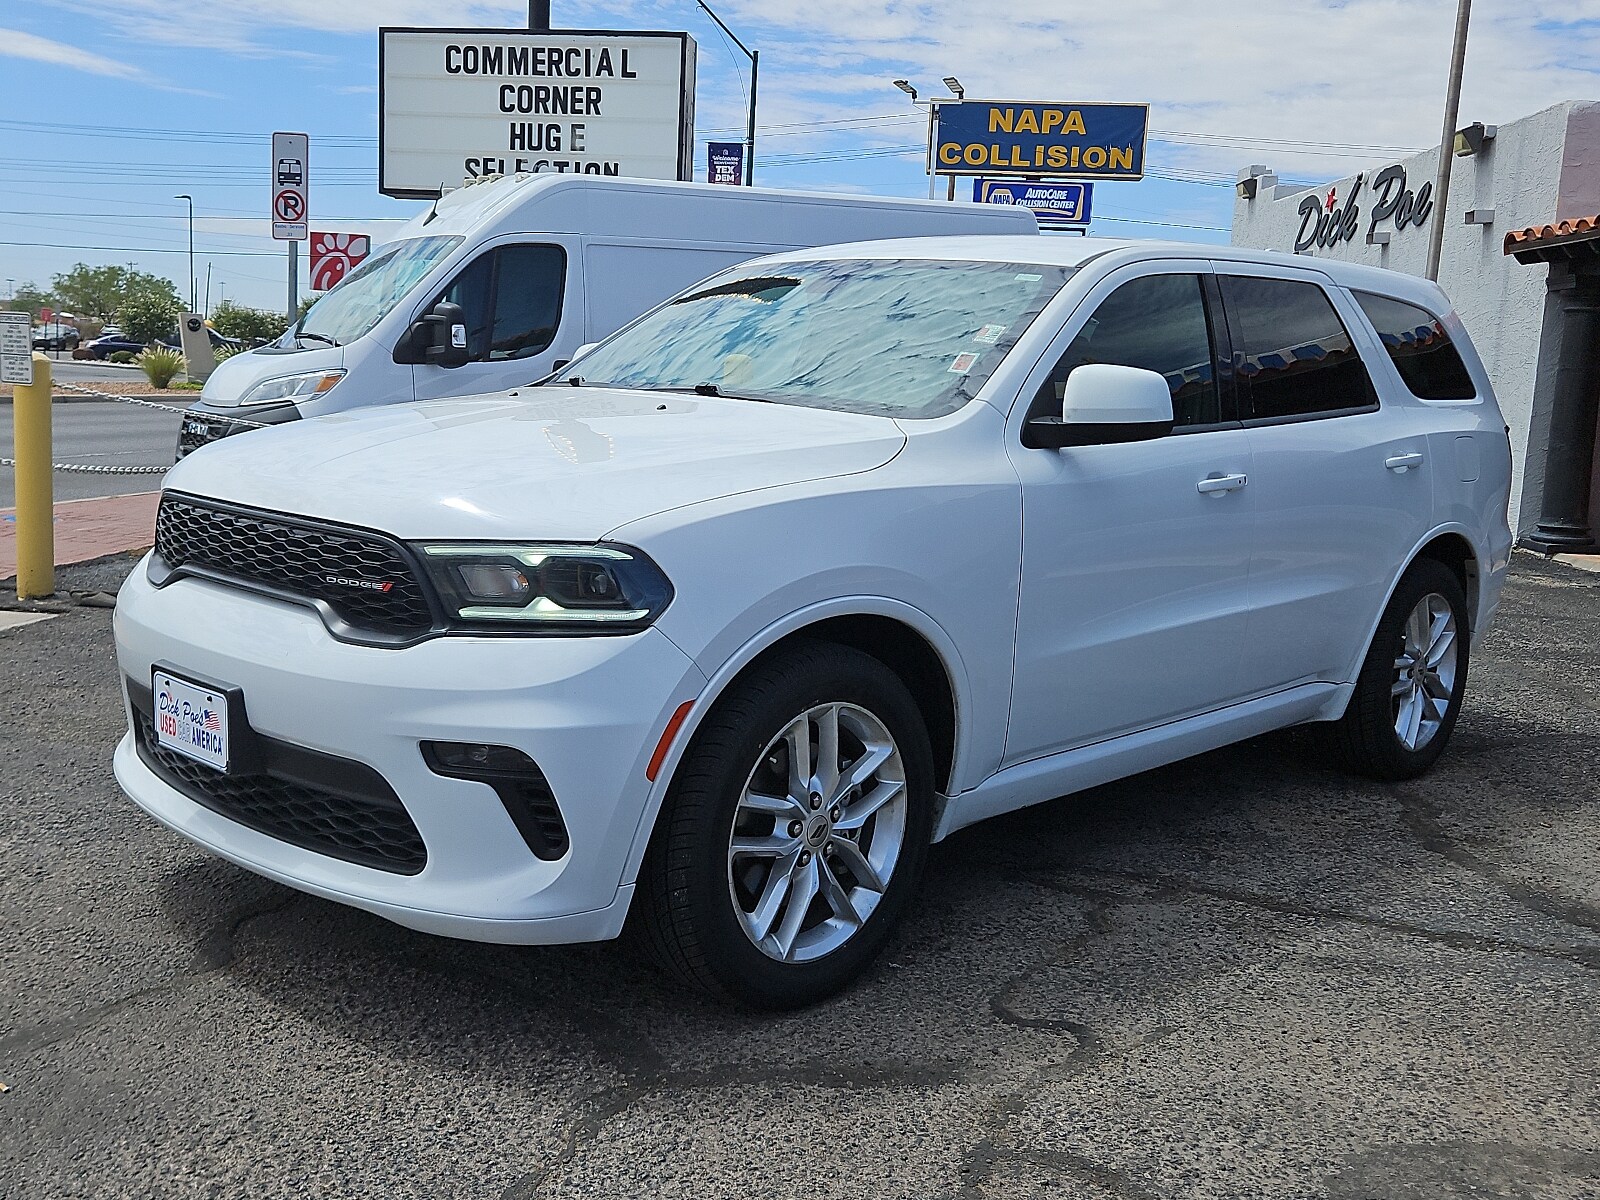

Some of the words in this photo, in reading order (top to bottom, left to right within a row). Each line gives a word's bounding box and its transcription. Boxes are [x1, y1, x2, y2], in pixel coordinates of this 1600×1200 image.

[445, 45, 637, 78] COMMERCIAL
[499, 85, 602, 115] CORNER
[988, 108, 1087, 135] NAPA
[939, 142, 1133, 169] COLLISION
[716, 166, 735, 174] TEX
[992, 193, 1011, 205] NAPA
[1015, 198, 1049, 208] COLLISION
[1049, 199, 1075, 209] CENTER
[1294, 173, 1364, 252] Dick
[1368, 164, 1434, 233] Poe
[326, 576, 384, 590] DODGE
[159, 691, 180, 717] Dick
[182, 701, 204, 726] Poe's
[160, 713, 177, 736] USED
[191, 727, 223, 756] AMERICA
